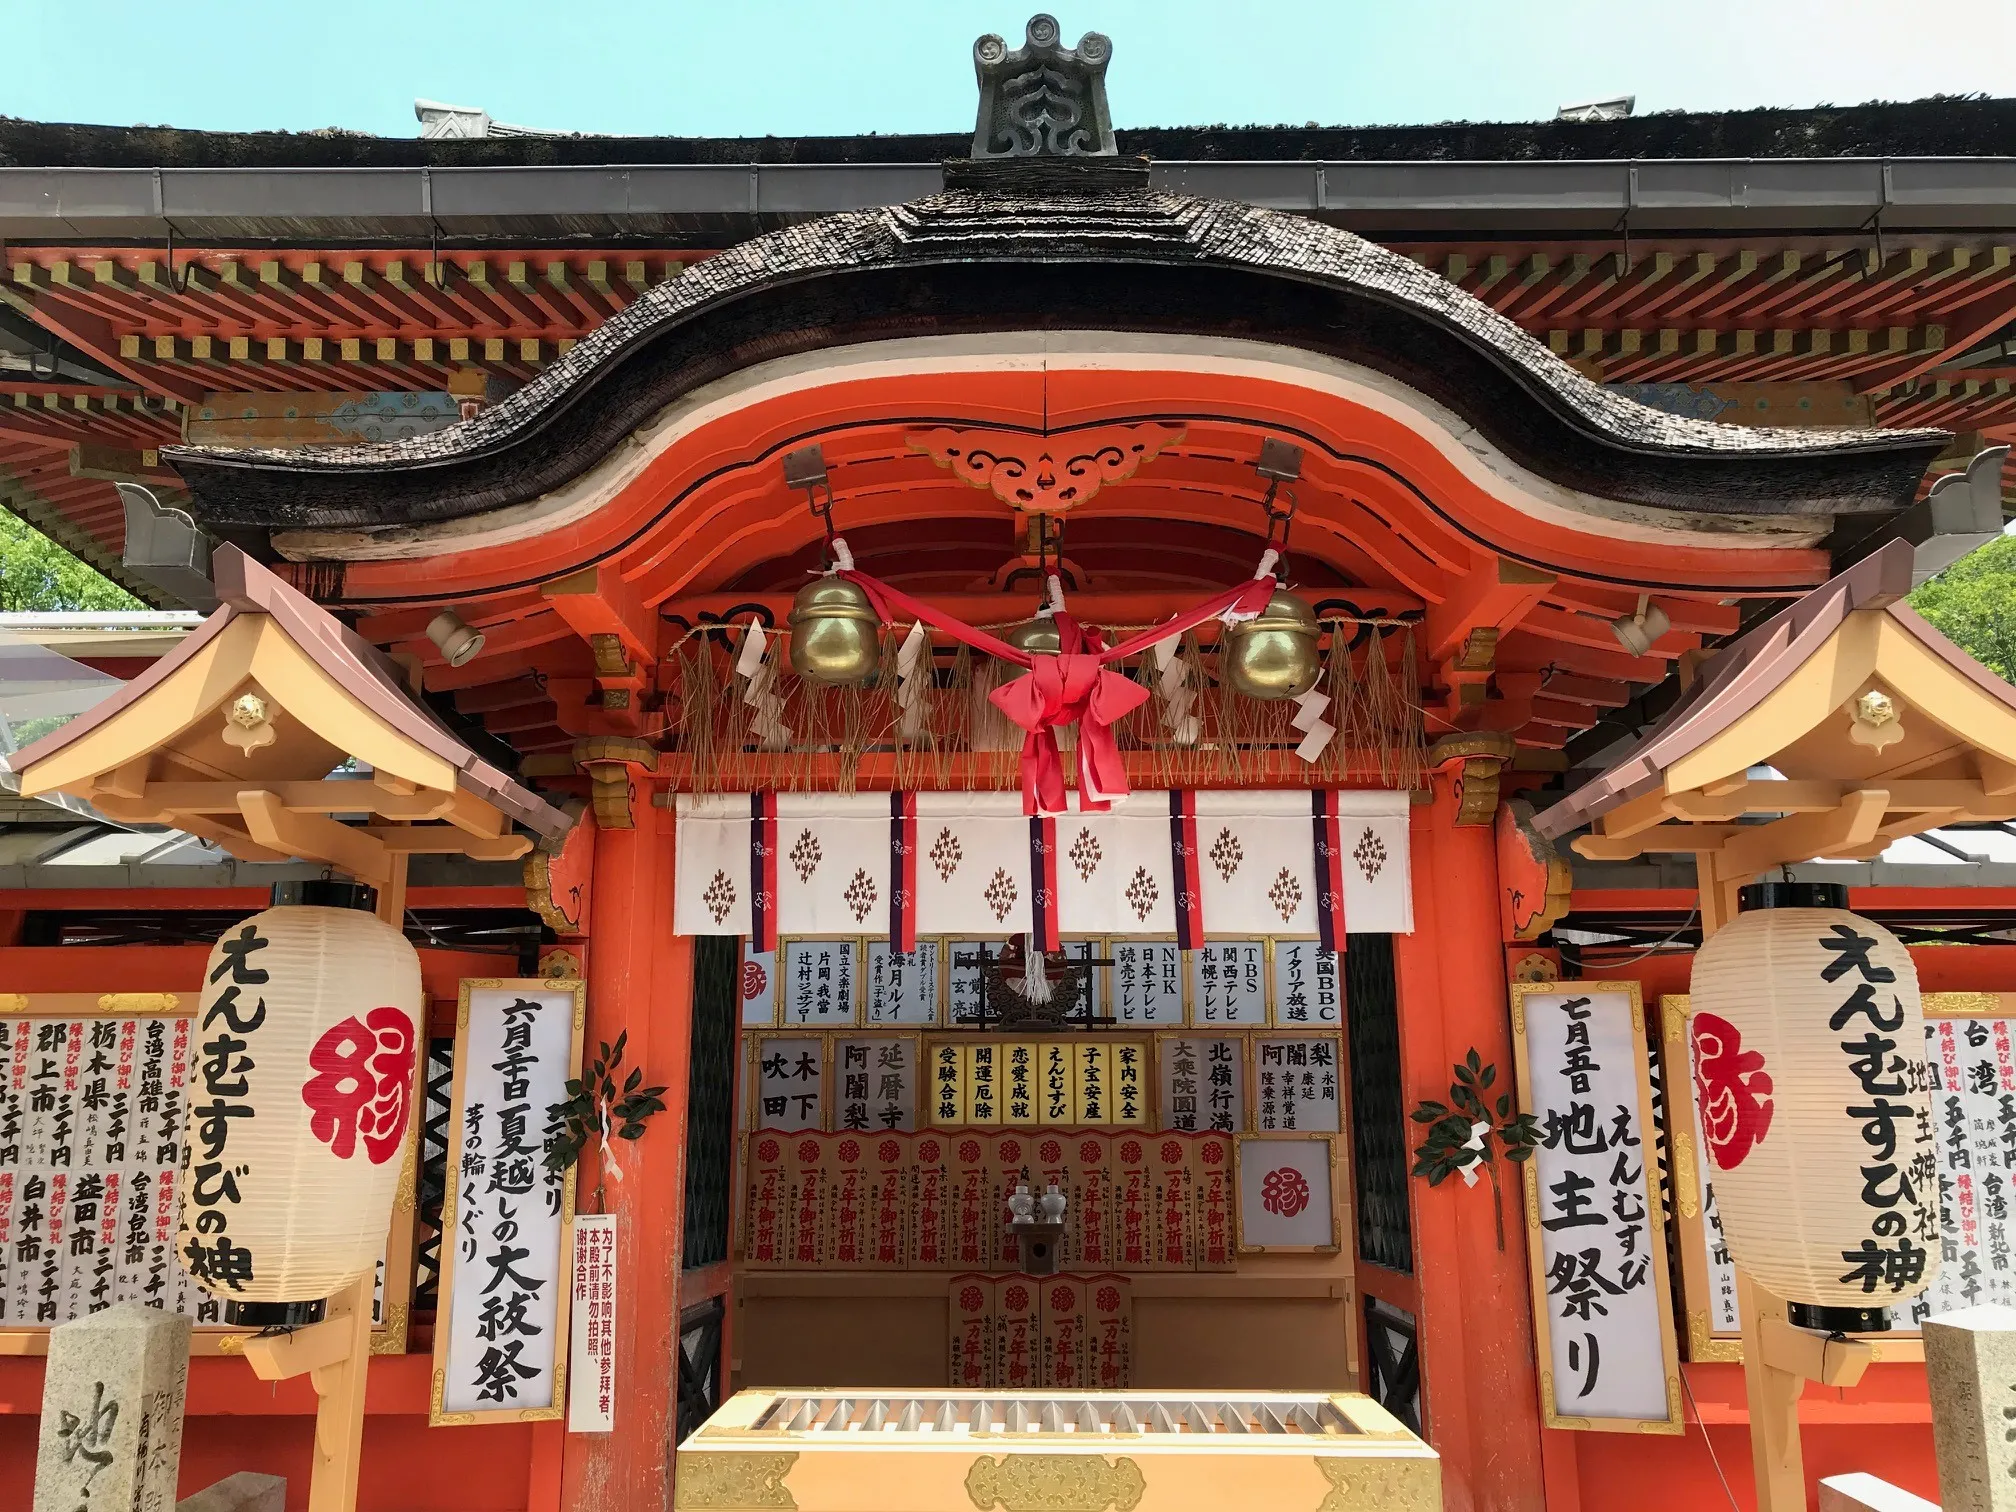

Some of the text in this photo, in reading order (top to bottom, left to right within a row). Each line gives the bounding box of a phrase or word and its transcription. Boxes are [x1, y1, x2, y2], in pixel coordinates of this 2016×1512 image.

[837, 943, 850, 1014] 国立文楽劇場
[888, 950, 906, 1020] 海月ルイ
[1119, 946, 1137, 1020] 読売テレビ
[1141, 947, 1158, 1020] 日本テレビ
[1162, 948, 1177, 994] NHK
[1201, 947, 1218, 1021] 札幌テレビ
[1222, 947, 1239, 1021] 関西テレビ
[1243, 948, 1258, 993] TBS
[1286, 945, 1309, 1022] イタリア放送
[1314, 948, 1336, 1021] 英国BBC
[11, 1021, 32, 1091] 縁結び御礼
[29, 1022, 68, 1113] 郡上市
[64, 1022, 84, 1092] 縁結び御礼
[81, 1021, 117, 1111] 栃木県
[116, 1021, 136, 1090] 縁結び御礼
[137, 1019, 166, 1114] 台湾高雄市
[169, 1019, 190, 1088] 縁結び御礼
[761, 1052, 790, 1118] 吹田
[791, 1051, 820, 1121] 木下
[877, 1043, 906, 1129] 延暦寺
[938, 1047, 957, 1119] 受験合格
[974, 1047, 993, 1119] 開運厄除
[1010, 1047, 1030, 1119] 恋愛成就
[1047, 1047, 1067, 1119] えんむすび
[1082, 1047, 1102, 1119] 子宝安産
[1118, 1047, 1138, 1119] 家内安全
[1208, 1043, 1234, 1132] 北嶺行満
[1938, 1021, 1961, 1092] 縁結び御礼
[1963, 1020, 1998, 1097] 台湾
[51, 1094, 74, 1168] 三千円
[105, 1092, 129, 1163] 三千円
[156, 1090, 182, 1165] 三千円
[184, 925, 269, 1292] えんむすびの神
[1945, 1095, 1971, 1170] 五千円
[16, 1174, 46, 1262] 白井市
[49, 1173, 68, 1245] 縁結び御礼
[69, 1173, 105, 1256] 益田市
[100, 1173, 120, 1245] 縁結び御礼
[125, 1171, 151, 1265] 台湾台北市
[156, 1170, 175, 1243] 縁結び御礼
[1608, 1104, 1651, 1292] えんむすび
[1957, 1174, 1978, 1246] 縁結び御礼
[1982, 1172, 2010, 1271] 台湾新北市
[37, 1249, 60, 1323] 三千円
[575, 1228, 587, 1301] 谢谢合作
[1959, 1250, 1982, 1309] 五千
